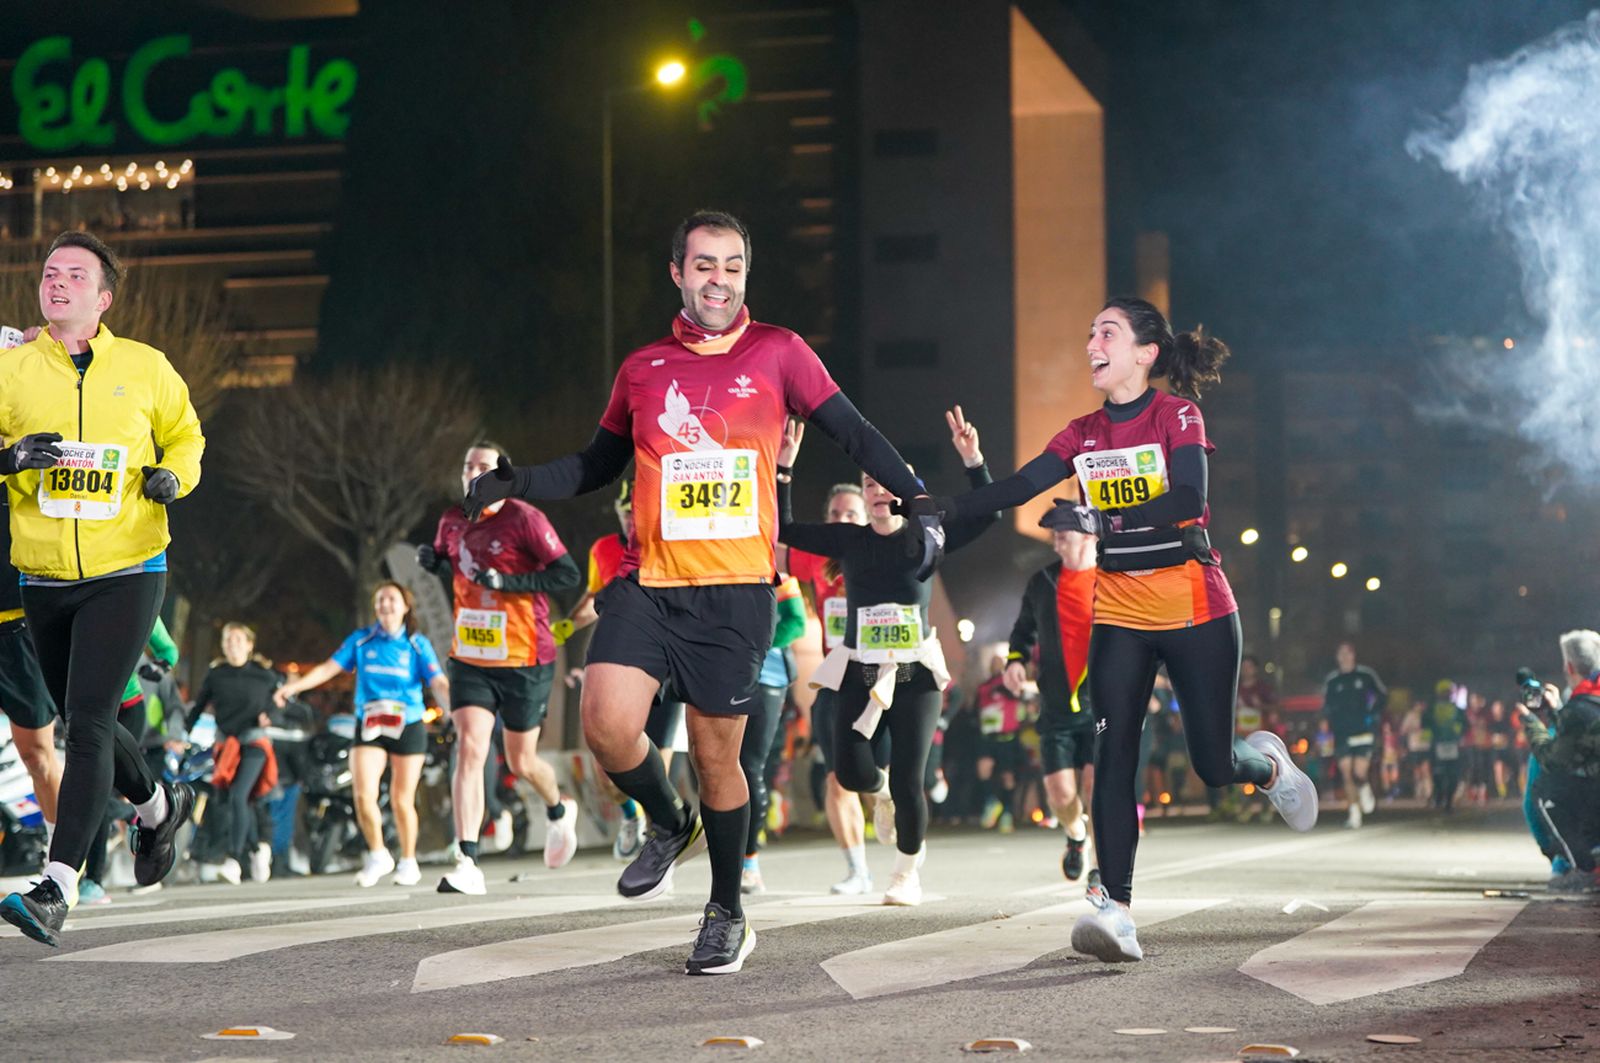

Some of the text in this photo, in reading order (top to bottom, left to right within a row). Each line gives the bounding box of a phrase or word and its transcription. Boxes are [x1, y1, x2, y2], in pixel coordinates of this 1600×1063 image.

[12, 34, 358, 149] El Corte
[677, 422, 701, 445] 43
[85, 450, 96, 460] DE
[1096, 459, 1119, 468] NOCHE
[1119, 458, 1128, 467] DE
[684, 461, 711, 470] NOCHE
[713, 460, 724, 469] DE
[49, 468, 113, 495] 13804
[673, 472, 691, 482] SAN
[1090, 470, 1104, 480] SAN
[680, 482, 742, 509] 3492
[1100, 477, 1151, 505] 4169
[871, 625, 911, 643] 3195
